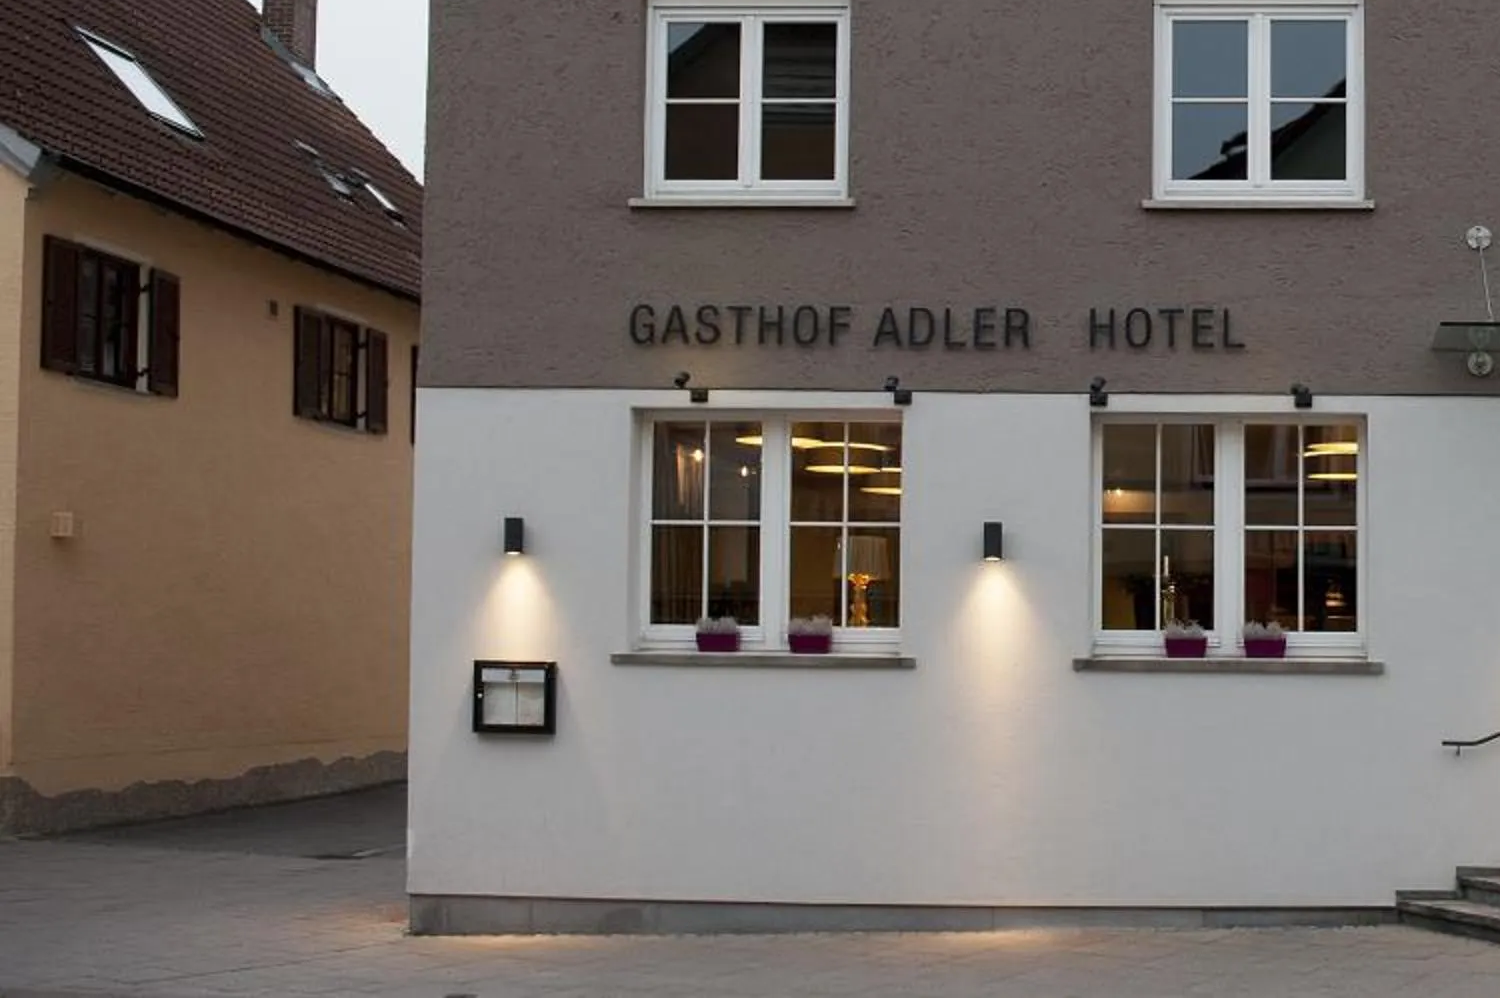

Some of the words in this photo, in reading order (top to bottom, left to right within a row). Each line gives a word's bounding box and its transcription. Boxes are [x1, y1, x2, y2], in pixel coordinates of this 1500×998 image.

[629, 304, 851, 346] GASTHOF
[873, 306, 1033, 350] ADLER
[1089, 308, 1247, 351] HOTEL
